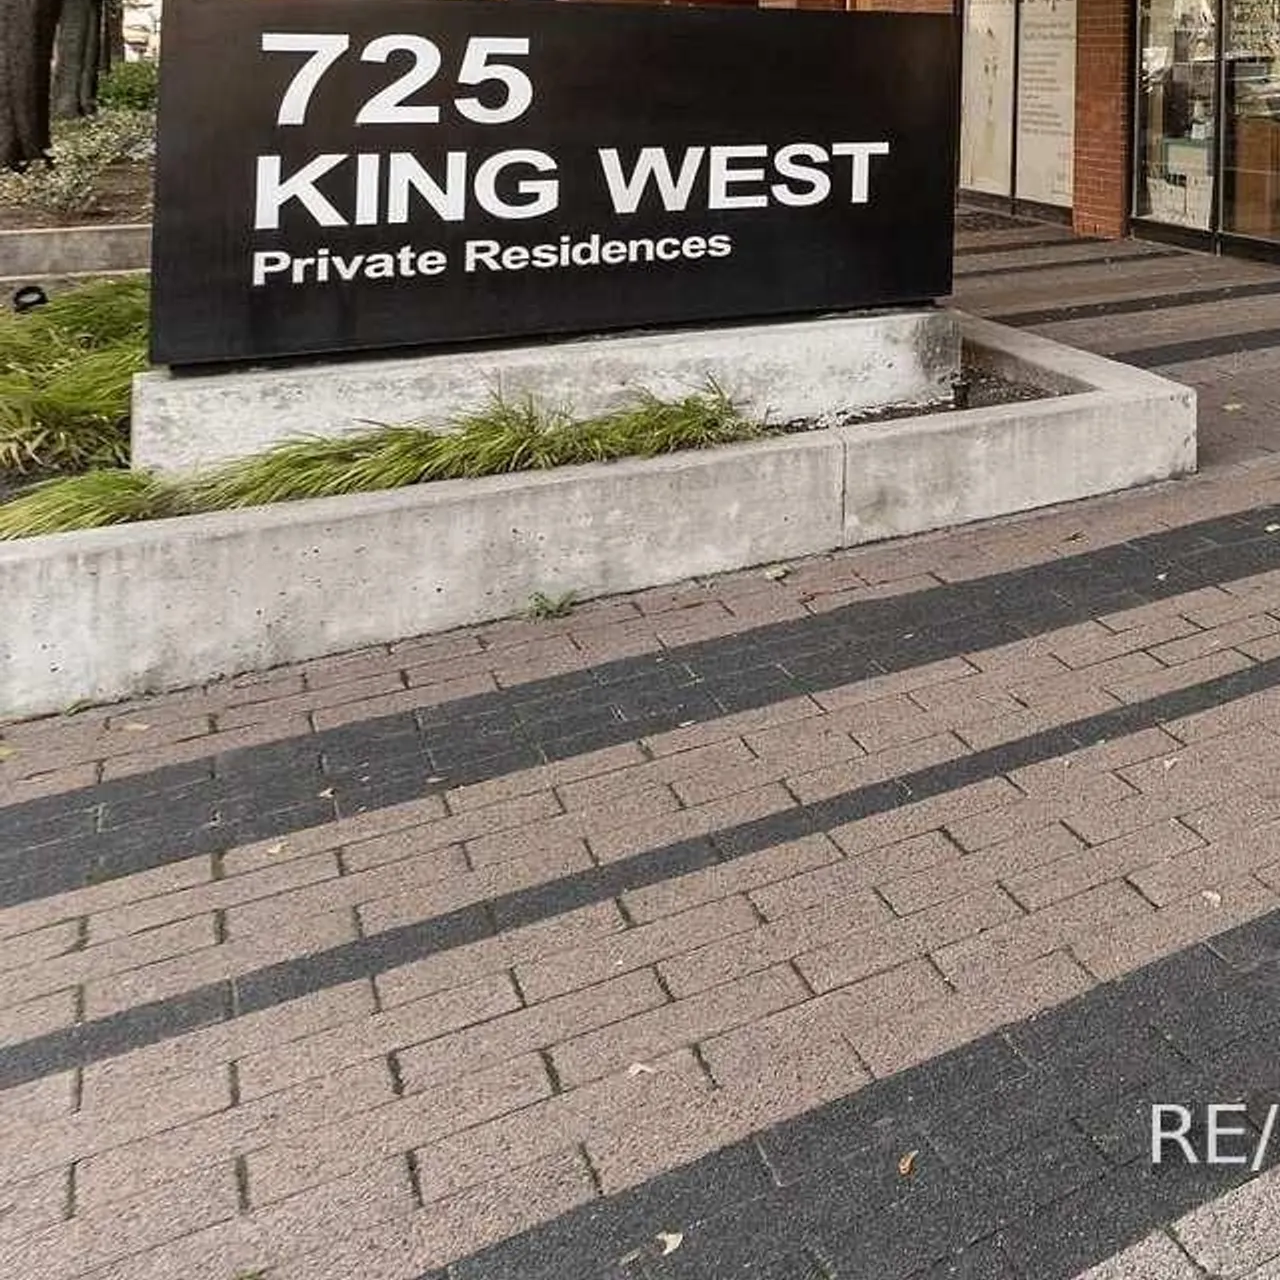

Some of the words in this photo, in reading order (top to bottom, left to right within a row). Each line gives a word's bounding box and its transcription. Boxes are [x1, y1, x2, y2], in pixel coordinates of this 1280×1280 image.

[262, 34, 533, 126] 725
[254, 150, 559, 230] KING
[599, 142, 889, 214] WEST
[253, 246, 447, 286] Private
[465, 234, 732, 272] Residences
